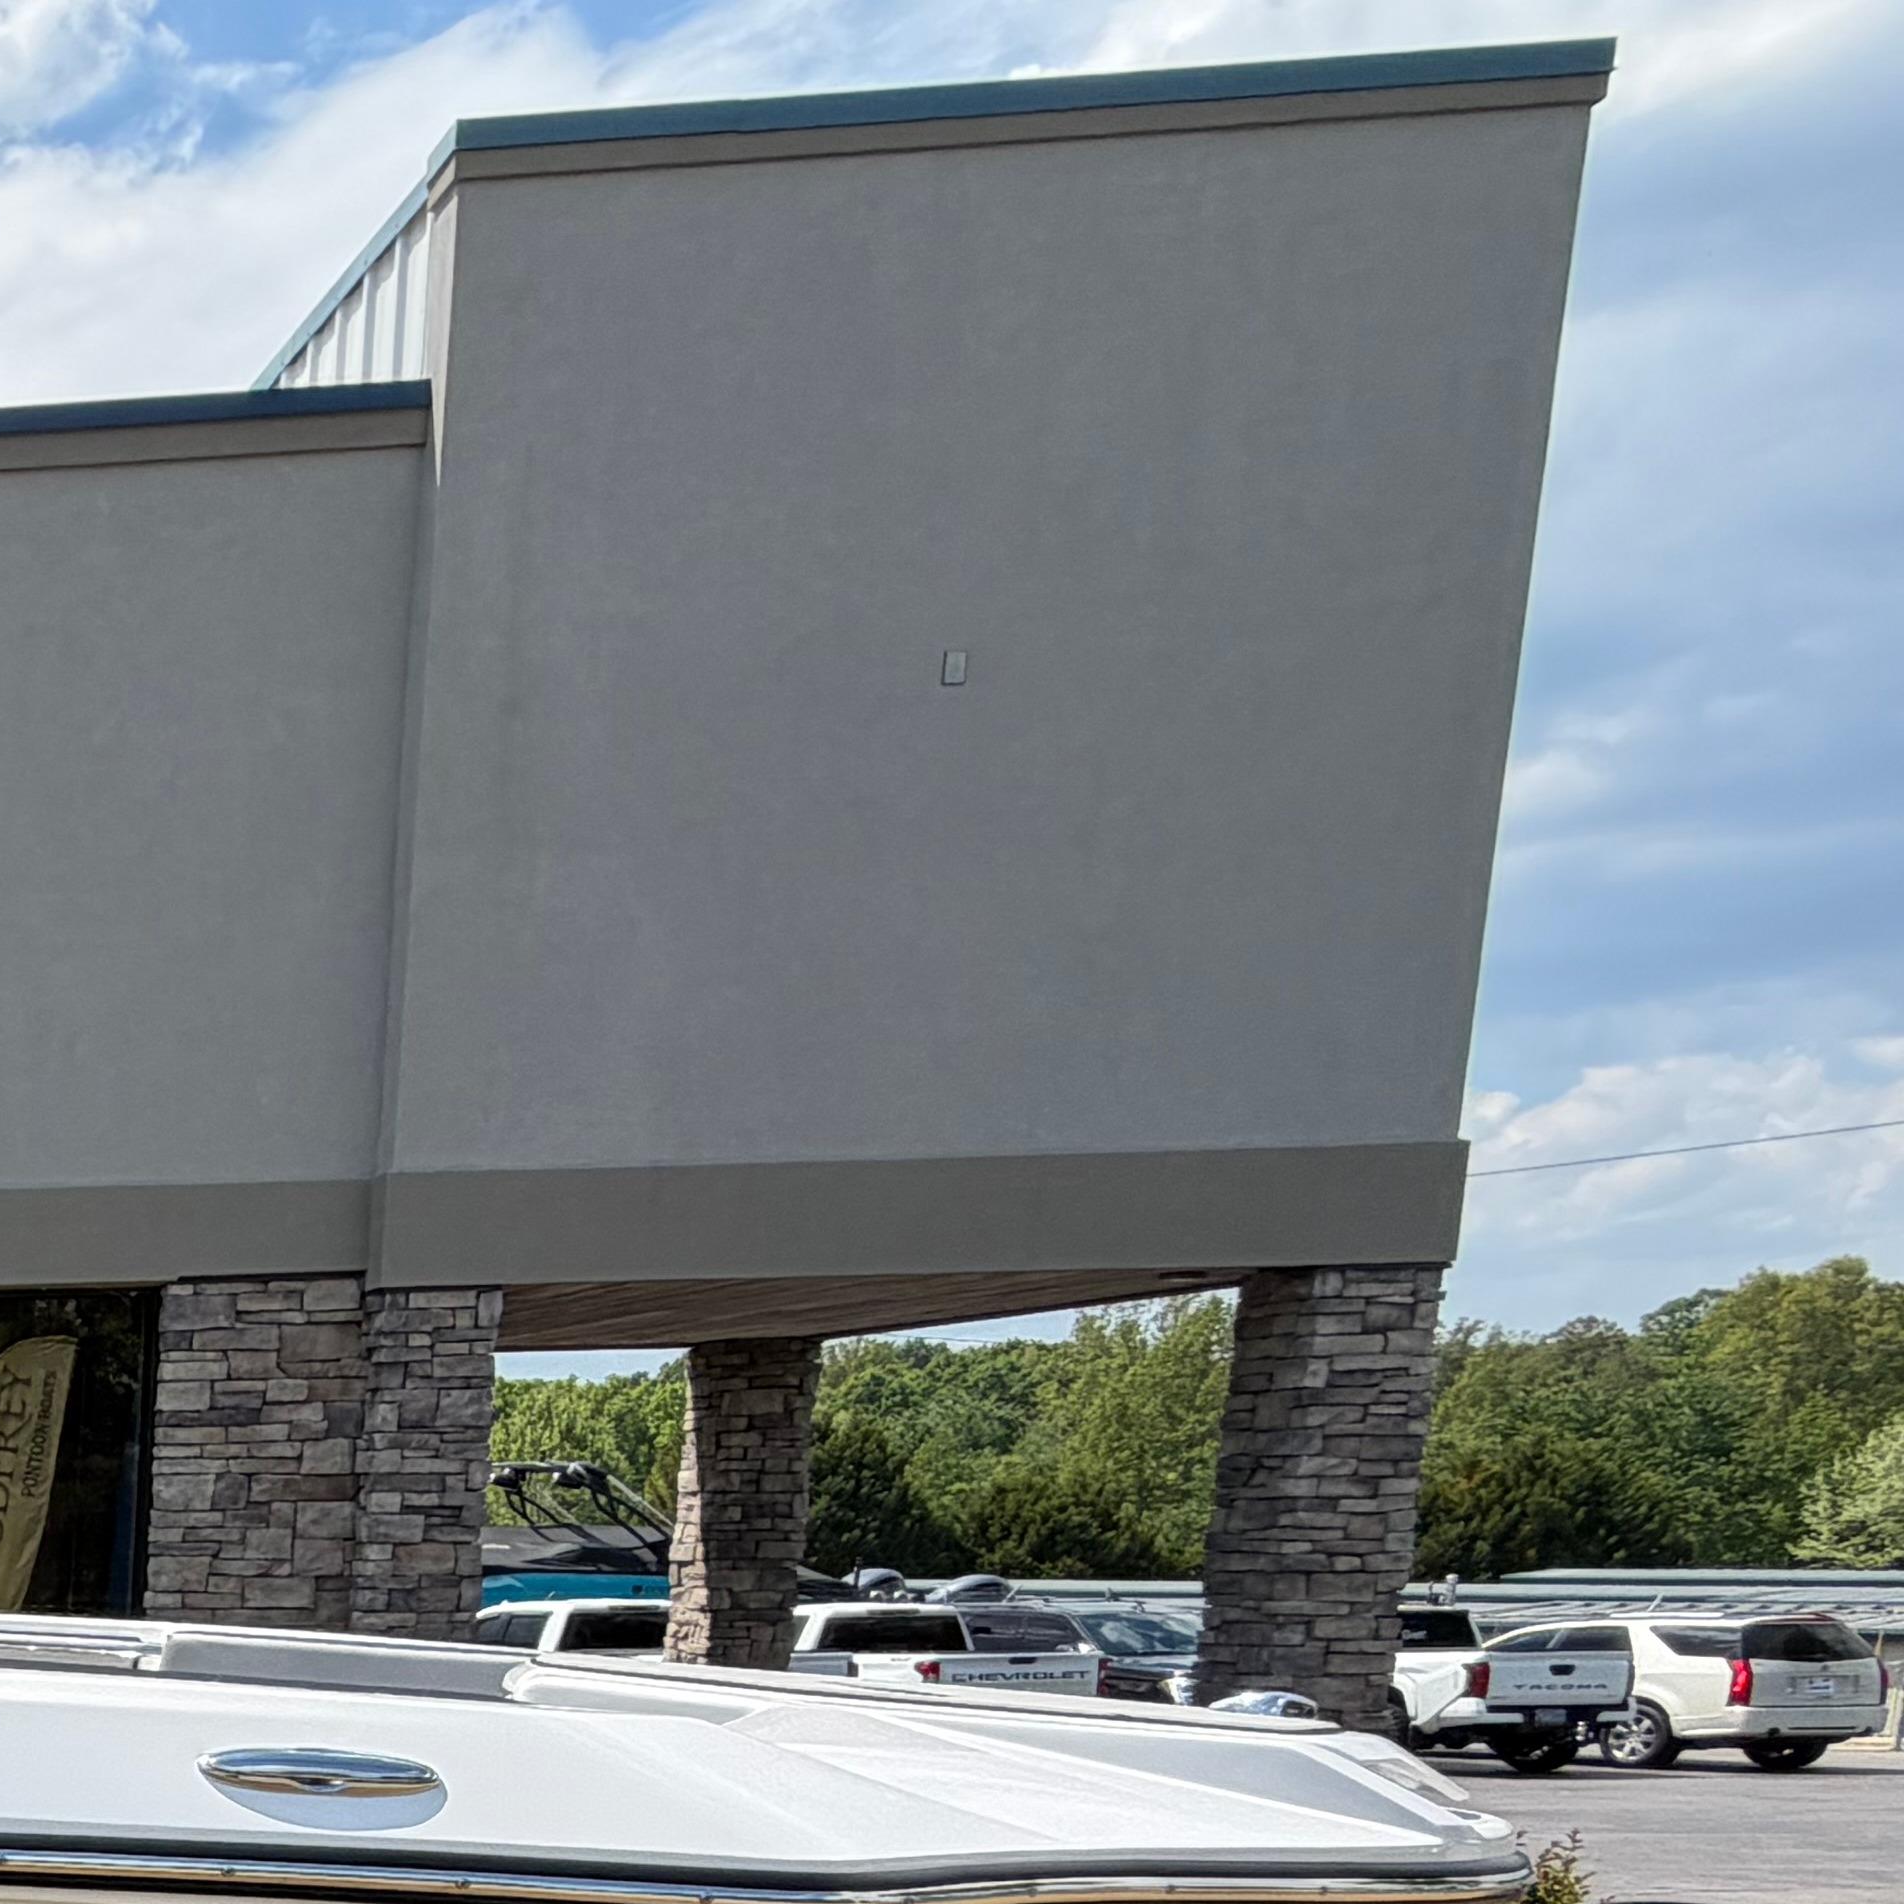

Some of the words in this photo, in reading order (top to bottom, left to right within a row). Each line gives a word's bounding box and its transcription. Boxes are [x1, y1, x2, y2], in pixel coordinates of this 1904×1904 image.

[21, 1424, 51, 1497] PONTOON
[37, 1369, 58, 1421] BOATS
[951, 1669, 1091, 1683] CHEVROLET
[1512, 1683, 1609, 1692] TACOMA
